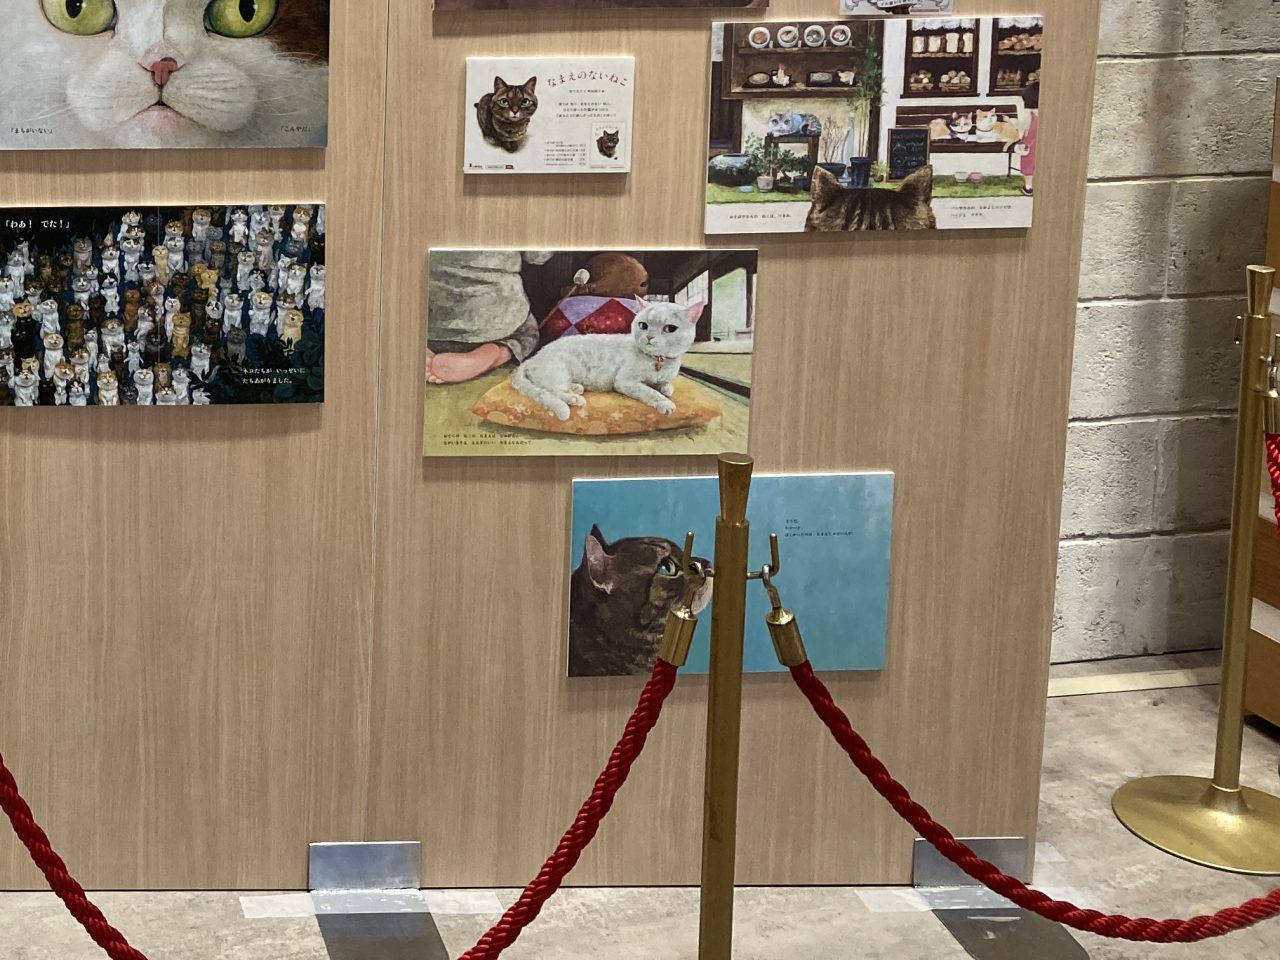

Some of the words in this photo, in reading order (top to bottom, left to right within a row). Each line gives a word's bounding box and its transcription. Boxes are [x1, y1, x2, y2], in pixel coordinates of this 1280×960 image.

[548, 70, 628, 87] なまえのないねこ
